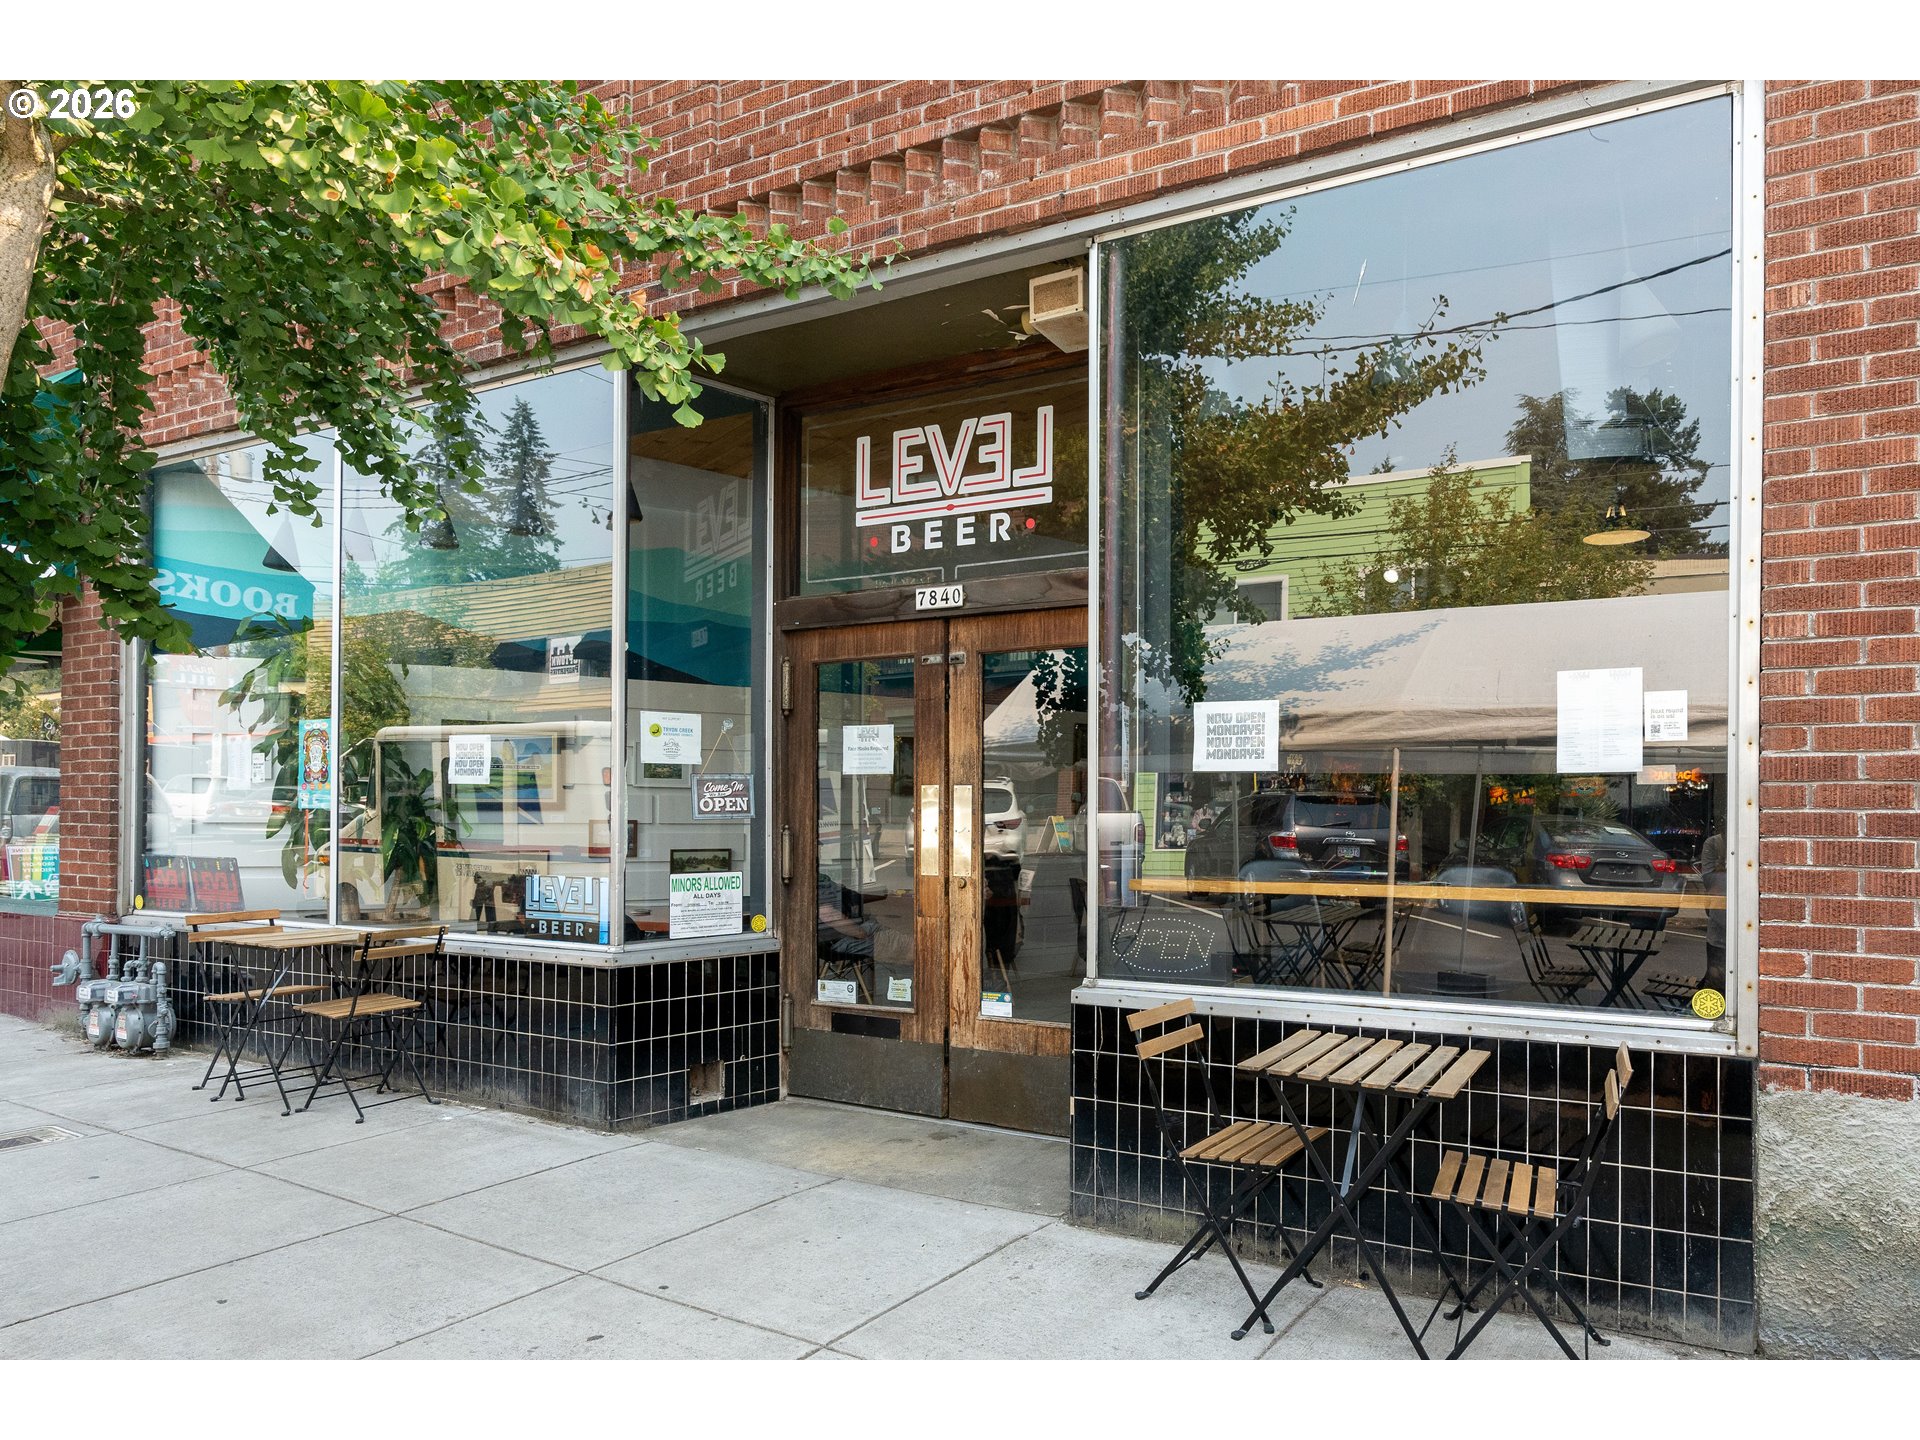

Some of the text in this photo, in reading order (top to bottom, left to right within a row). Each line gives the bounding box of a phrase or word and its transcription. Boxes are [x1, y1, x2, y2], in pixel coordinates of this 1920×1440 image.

[855, 405, 1053, 508] LEVEL
[891, 512, 1011, 554] BEER
[917, 588, 961, 607] 7840
[1206, 712, 1266, 724] NOW OPEN
[1206, 724, 1265, 736] MONDAYS!
[1206, 736, 1265, 748] NOW OPEN
[1205, 748, 1265, 760] MONDAYS!
[703, 781, 744, 793] Come In
[699, 797, 749, 812] OPEN
[671, 876, 741, 893] MINORS ALLOWED
[525, 875, 600, 915] LEVEL
[538, 919, 585, 937] BEER
[1112, 928, 1216, 962] OPEN
